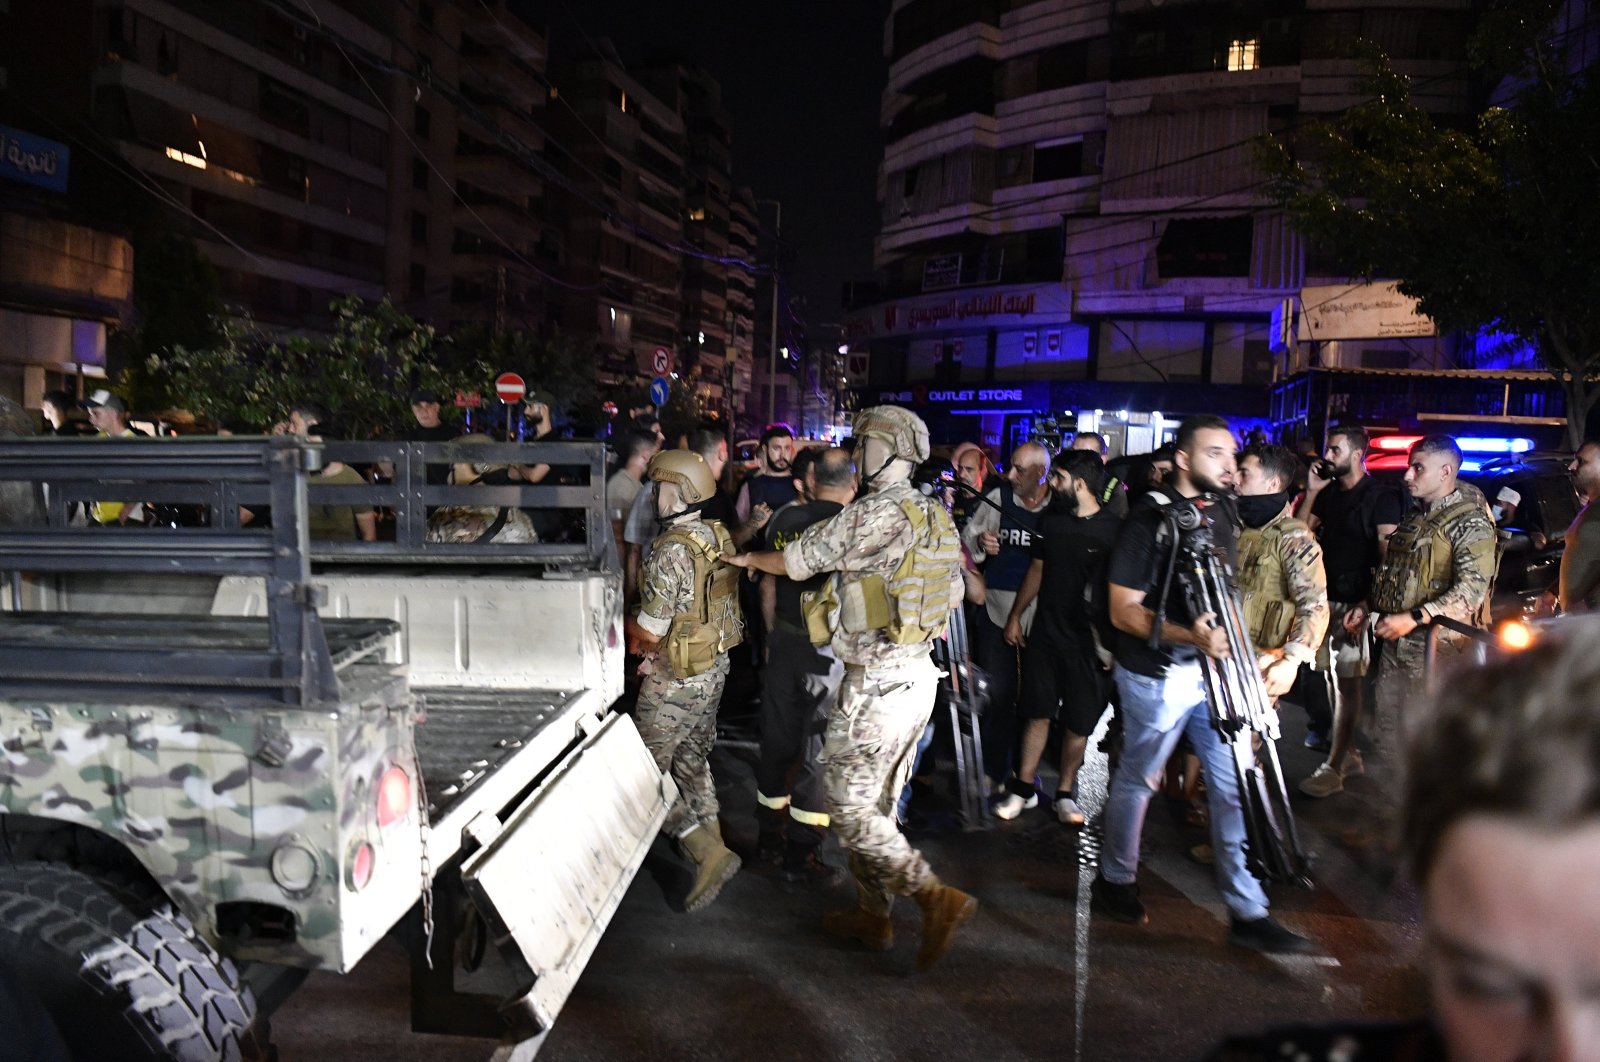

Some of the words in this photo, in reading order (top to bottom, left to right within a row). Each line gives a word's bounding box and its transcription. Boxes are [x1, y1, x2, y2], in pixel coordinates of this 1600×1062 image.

[8, 139, 57, 176] ثانوية
[960, 294, 1003, 320] اللبناني
[1004, 294, 1034, 317] البنك
[928, 389, 975, 401] OUTLET
[978, 389, 1022, 401] STORE
[1000, 529, 1031, 546] PRE
